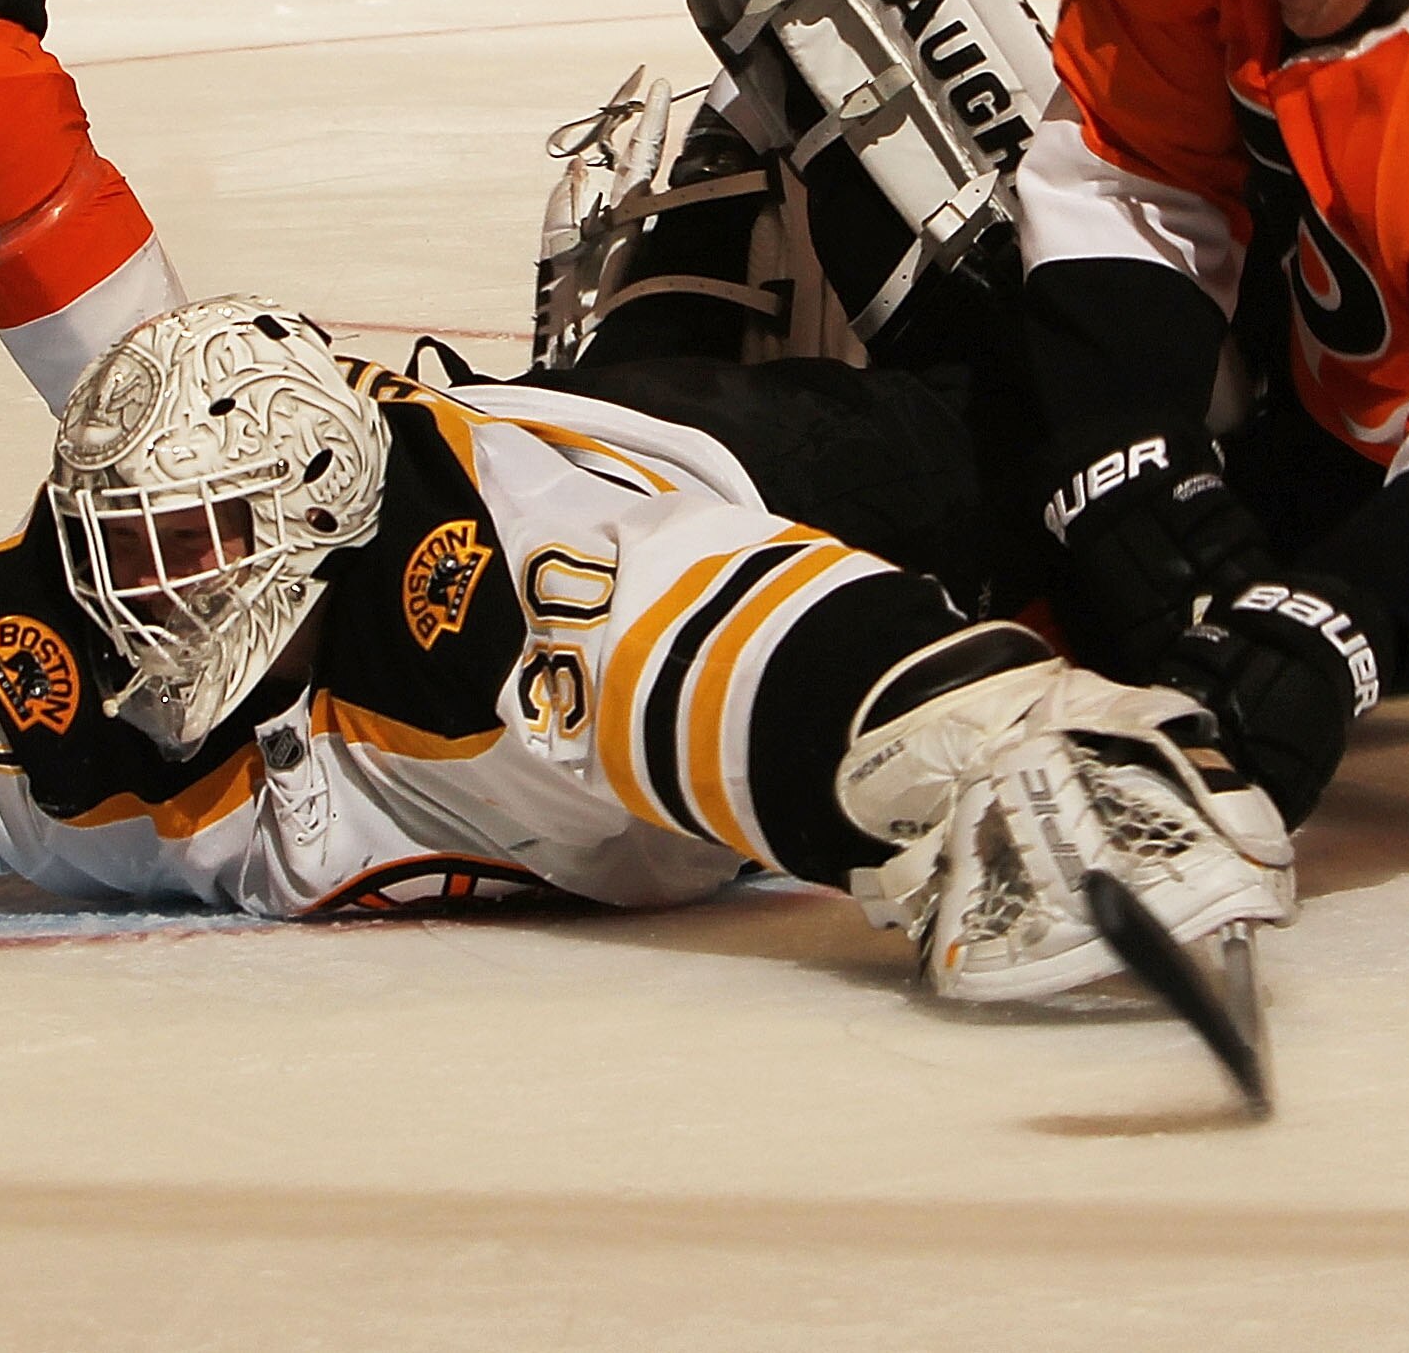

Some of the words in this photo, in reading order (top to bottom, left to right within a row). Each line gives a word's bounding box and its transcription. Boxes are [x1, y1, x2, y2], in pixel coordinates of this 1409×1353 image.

[408, 526, 470, 640] BOSTON
[518, 542, 618, 740] 30
[1232, 585, 1380, 719] BAUER
